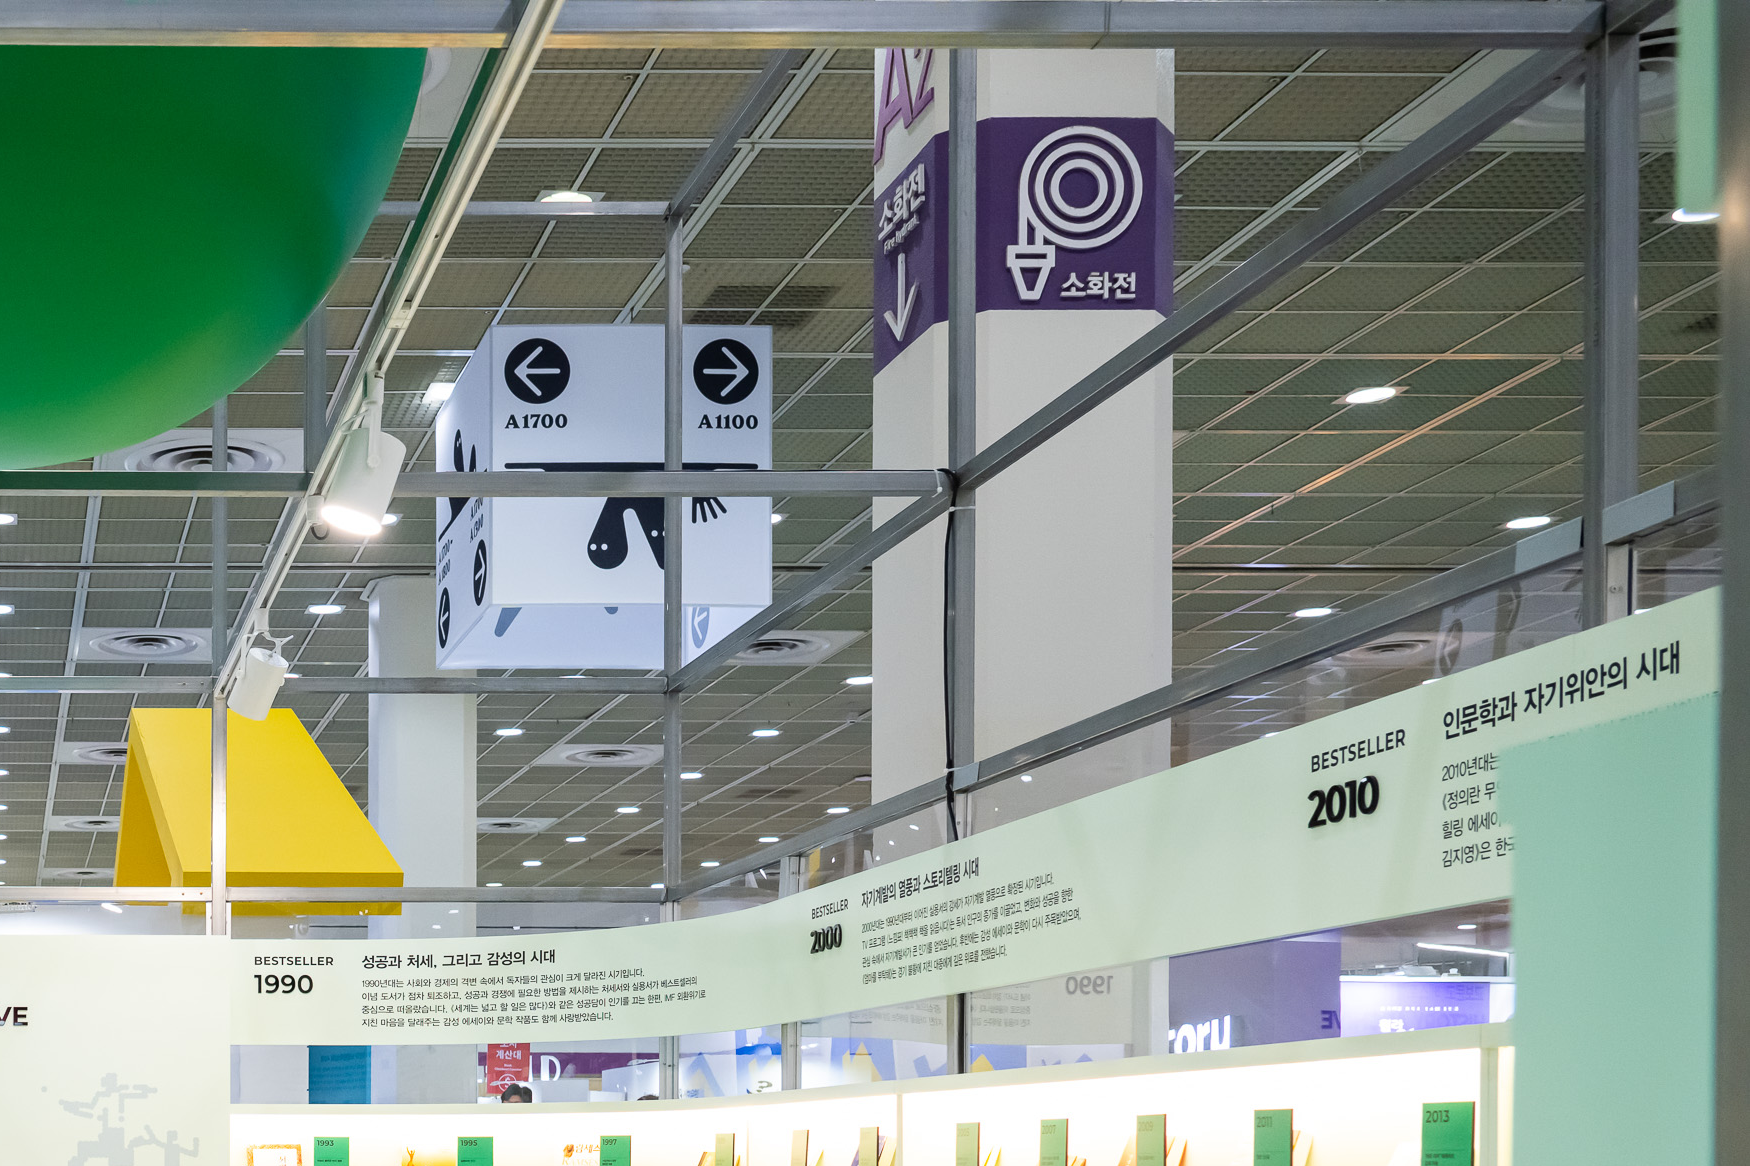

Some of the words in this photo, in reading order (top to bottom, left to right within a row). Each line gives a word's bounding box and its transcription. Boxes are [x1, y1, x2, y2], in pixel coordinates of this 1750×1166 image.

[878, 163, 925, 240] 소화전
[1060, 272, 1136, 299] 소화전
[504, 414, 568, 430] A1700
[697, 414, 759, 430] A1100
[1442, 691, 1518, 740] 인문학과
[1523, 657, 1628, 715] 자기위안의
[1635, 640, 1681, 681] 시대
[1310, 728, 1406, 773] BESTSELLER
[1307, 775, 1381, 829] 2010
[1442, 818, 1463, 840] 힐링
[862, 882, 896, 908] 자기계발의
[899, 875, 921, 898] 열풍과
[923, 864, 960, 890] 스토리텔링
[963, 857, 979, 879] 시대
[811, 898, 849, 920] BESTSELLER
[810, 924, 843, 954] 2000
[254, 956, 335, 967] BESTSELLER
[362, 955, 402, 969] 성공과
[407, 954, 437, 968] 처세,
[442, 953, 482, 967] 그리고
[487, 951, 525, 966] 감성의
[530, 949, 555, 964] 시대
[254, 974, 314, 994] 1990
[362, 979, 404, 988] 1990년대는
[407, 979, 431, 987] 사회와
[435, 978, 458, 987] 경제의
[461, 978, 477, 986] 격변
[480, 976, 503, 985] 속에서
[506, 975, 538, 984] 독자들의
[540, 974, 563, 983] 관심이
[566, 973, 581, 981] 크게
[584, 971, 606, 981] 달라진
[608, 968, 644, 979] 시기입니다.
[1425, 1110, 1450, 1124] 2013
[317, 1139, 334, 1147] 1993
[460, 1139, 478, 1147] 1995
[602, 1138, 617, 1146] 1997
